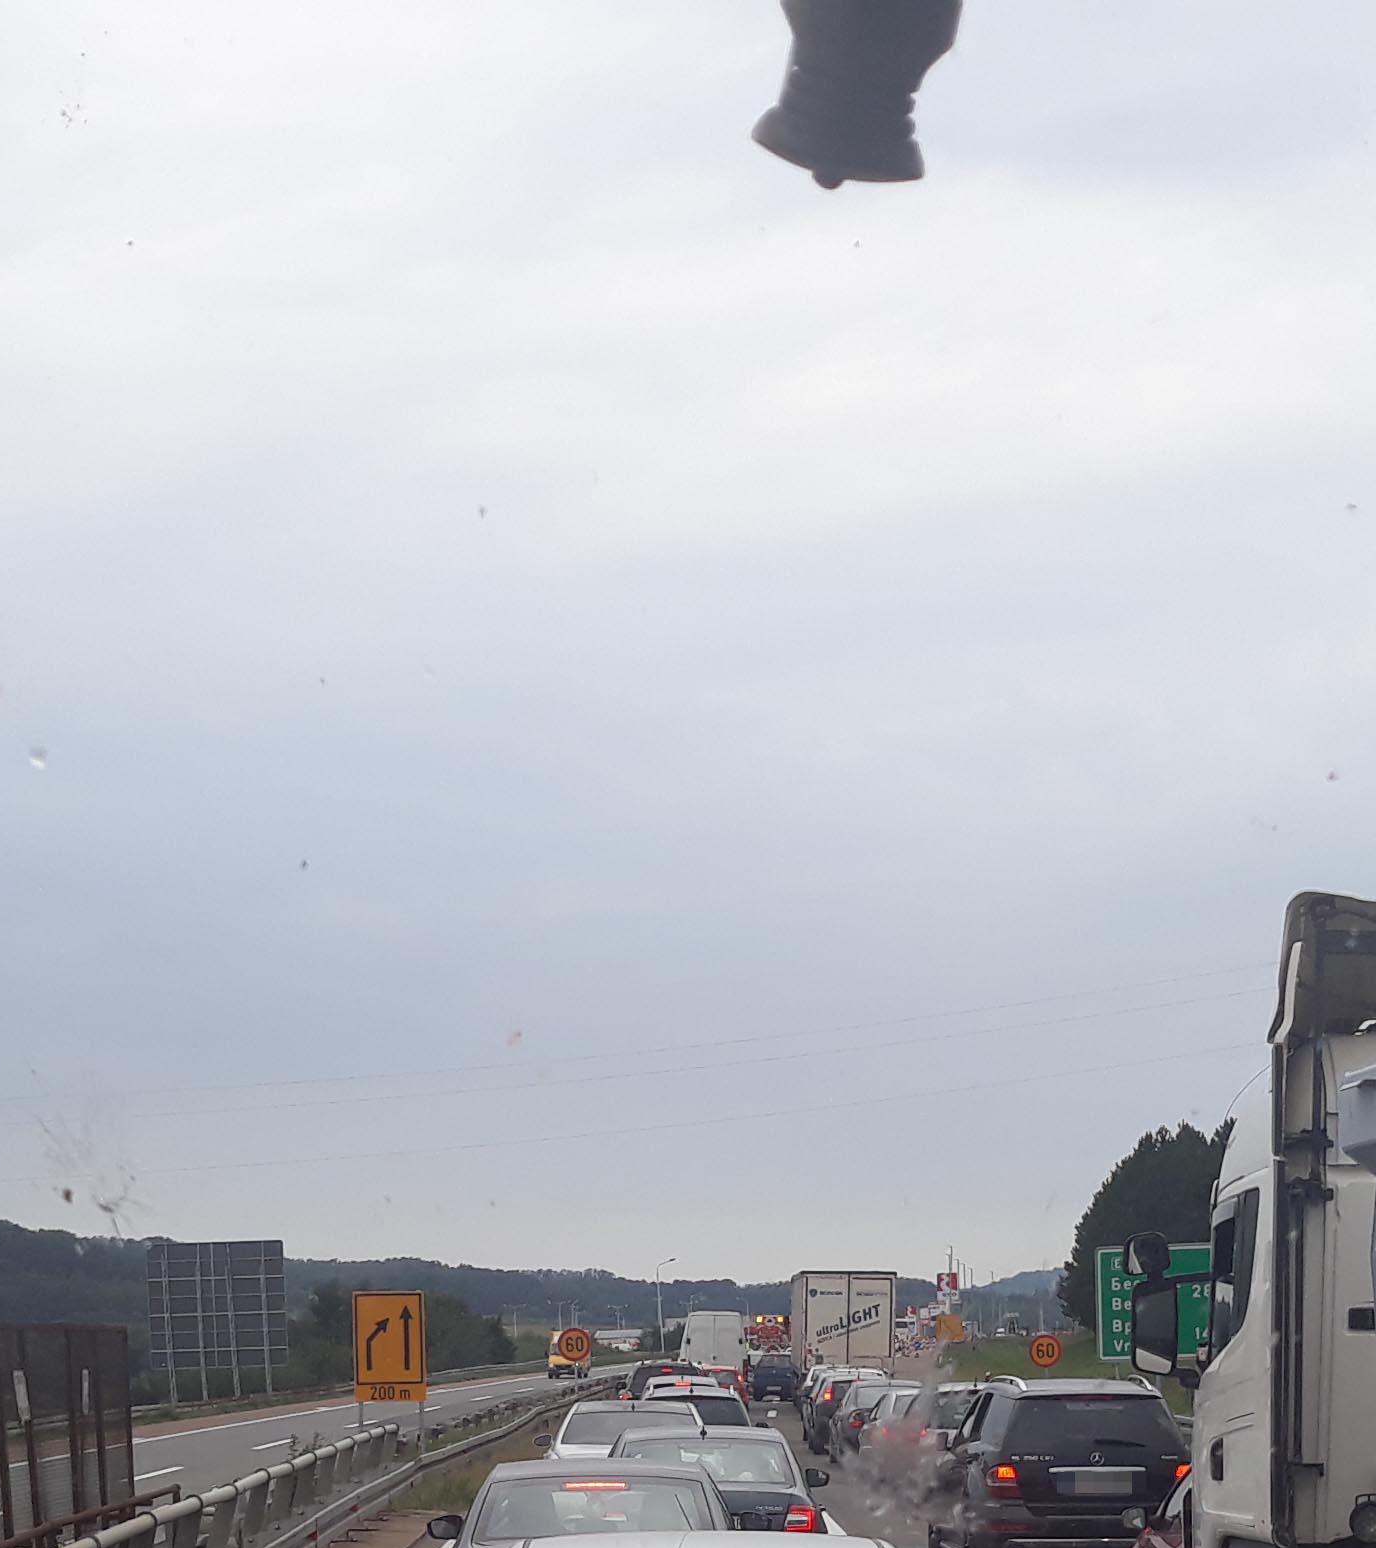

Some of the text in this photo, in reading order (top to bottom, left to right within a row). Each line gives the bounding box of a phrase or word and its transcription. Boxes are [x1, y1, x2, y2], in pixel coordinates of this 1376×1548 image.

[565, 1336, 584, 1353] 60
[1036, 1342, 1055, 1359] 60
[370, 1385, 411, 1400] 200 m
